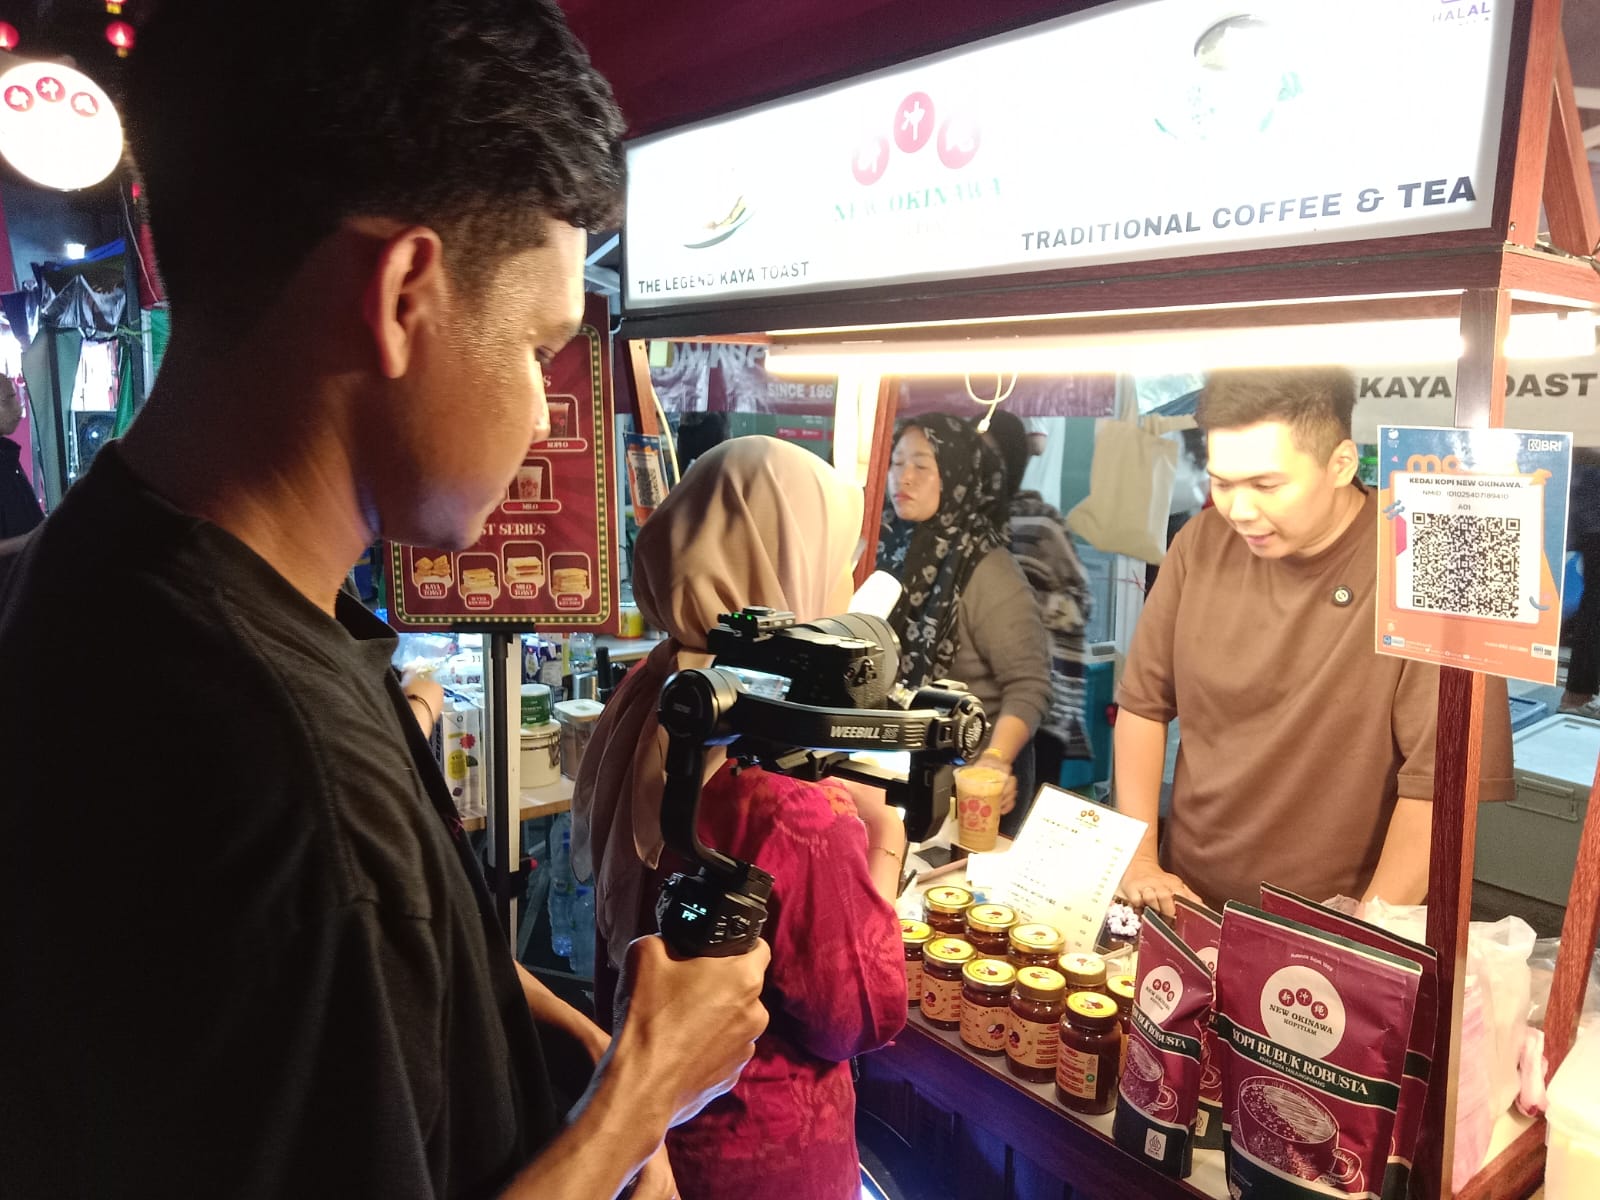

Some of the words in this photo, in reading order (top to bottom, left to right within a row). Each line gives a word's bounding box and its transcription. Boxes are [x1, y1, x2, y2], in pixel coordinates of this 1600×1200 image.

[1432, 2, 1491, 23] HALAL
[1021, 211, 1201, 251] TRADITIONAL
[1212, 192, 1343, 229] COFFEE
[1356, 188, 1385, 212] &
[1397, 175, 1477, 208] TEA
[638, 279, 661, 294] THE
[665, 273, 715, 291] LEGEND
[719, 267, 755, 286] KAYA
[760, 261, 810, 281] TOAST
[767, 383, 804, 399] SINCE
[1359, 375, 1453, 398] KAYA
[1505, 372, 1599, 398] AST
[1541, 440, 1563, 452] BRI
[1409, 477, 1433, 485] KEDAI
[1435, 478, 1455, 486] KOPI
[1456, 479, 1477, 487] NEW
[499, 522, 546, 536] SERIES
[830, 725, 880, 739] WEEBILL
[1268, 1003, 1290, 1018] NEW
[1291, 1013, 1334, 1035] OKINAWA
[1283, 1018, 1318, 1037] KOPITIAM
[1257, 1041, 1301, 1070] BUBUK
[1303, 1061, 1369, 1096] ROBUSTA
